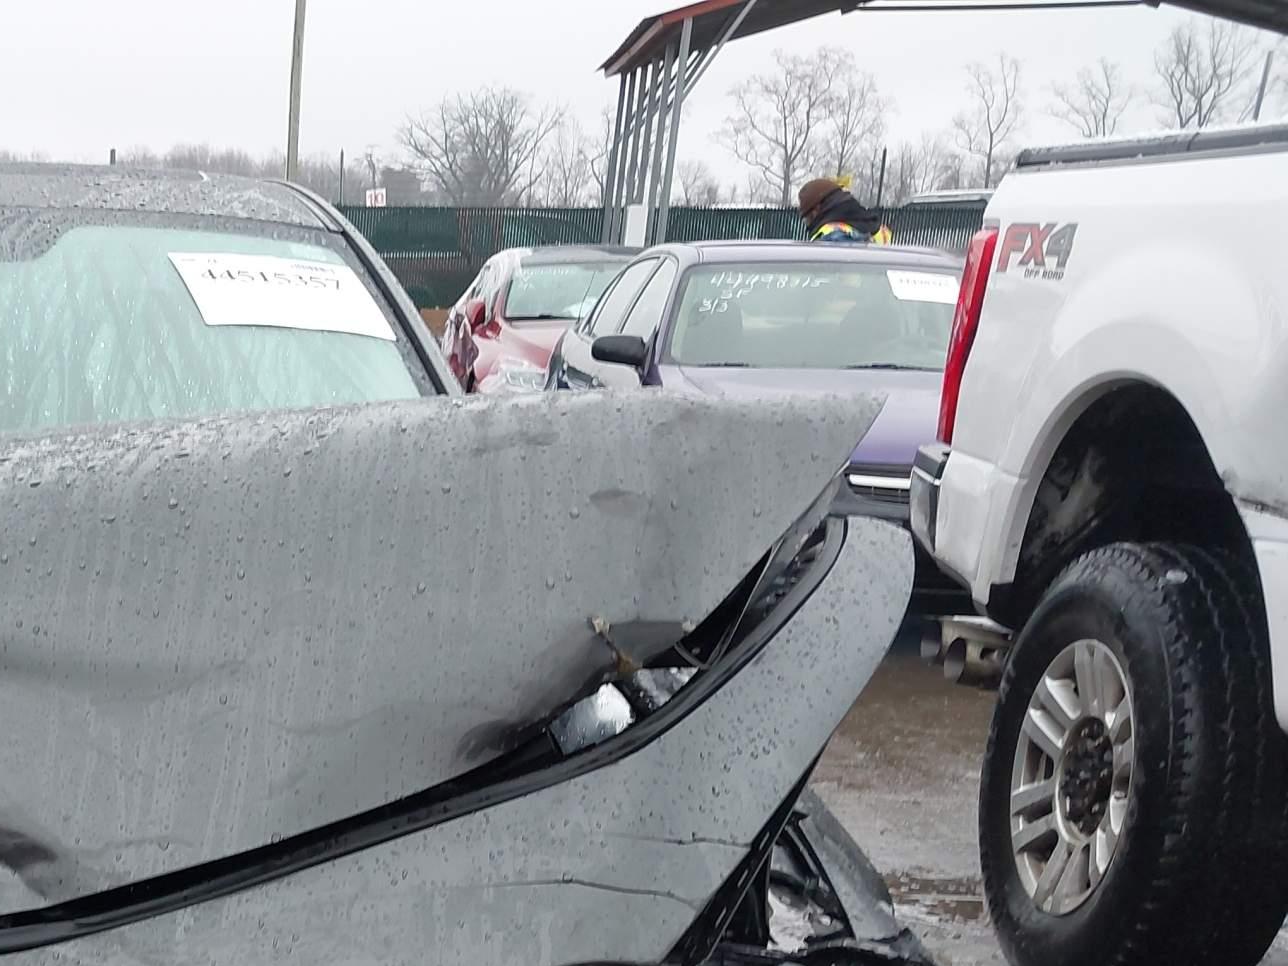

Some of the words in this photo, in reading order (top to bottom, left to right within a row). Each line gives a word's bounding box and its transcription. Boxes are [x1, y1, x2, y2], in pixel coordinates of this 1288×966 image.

[996, 223, 1078, 273] FX4
[201, 269, 340, 290] 44515357
[1024, 268, 1040, 279] OFF
[1042, 270, 1064, 280] ROAD
